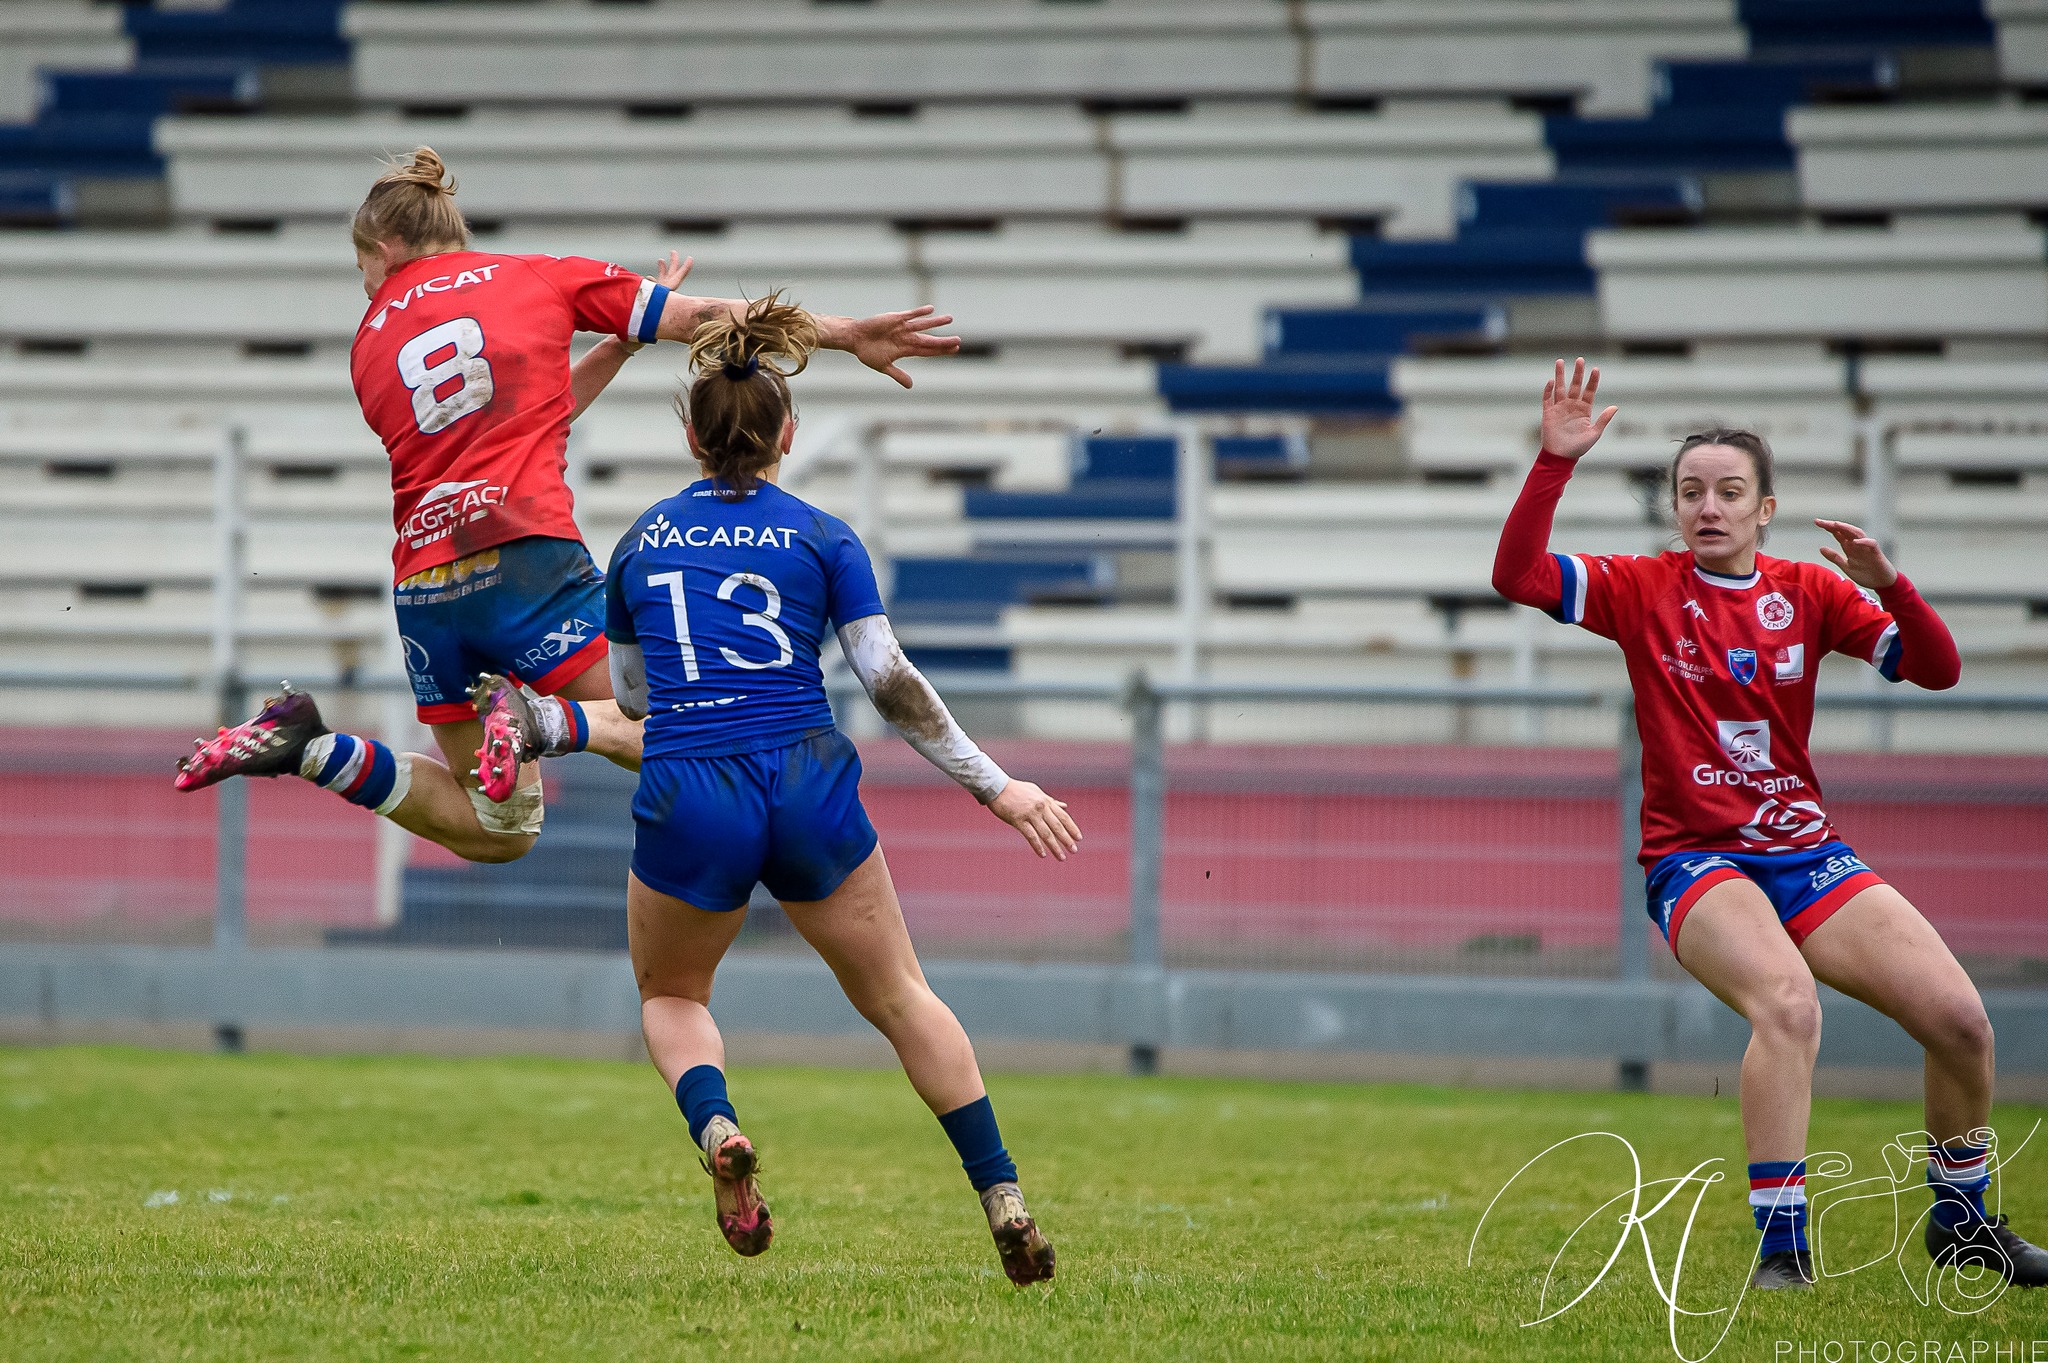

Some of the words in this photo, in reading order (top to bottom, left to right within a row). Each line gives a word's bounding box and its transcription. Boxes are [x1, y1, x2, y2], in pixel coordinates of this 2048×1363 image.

[390, 263, 500, 311] VICAT
[396, 316, 495, 436] 8
[638, 525, 798, 552] NACARAT
[515, 618, 594, 673] AREXA
[647, 571, 794, 682] 13
